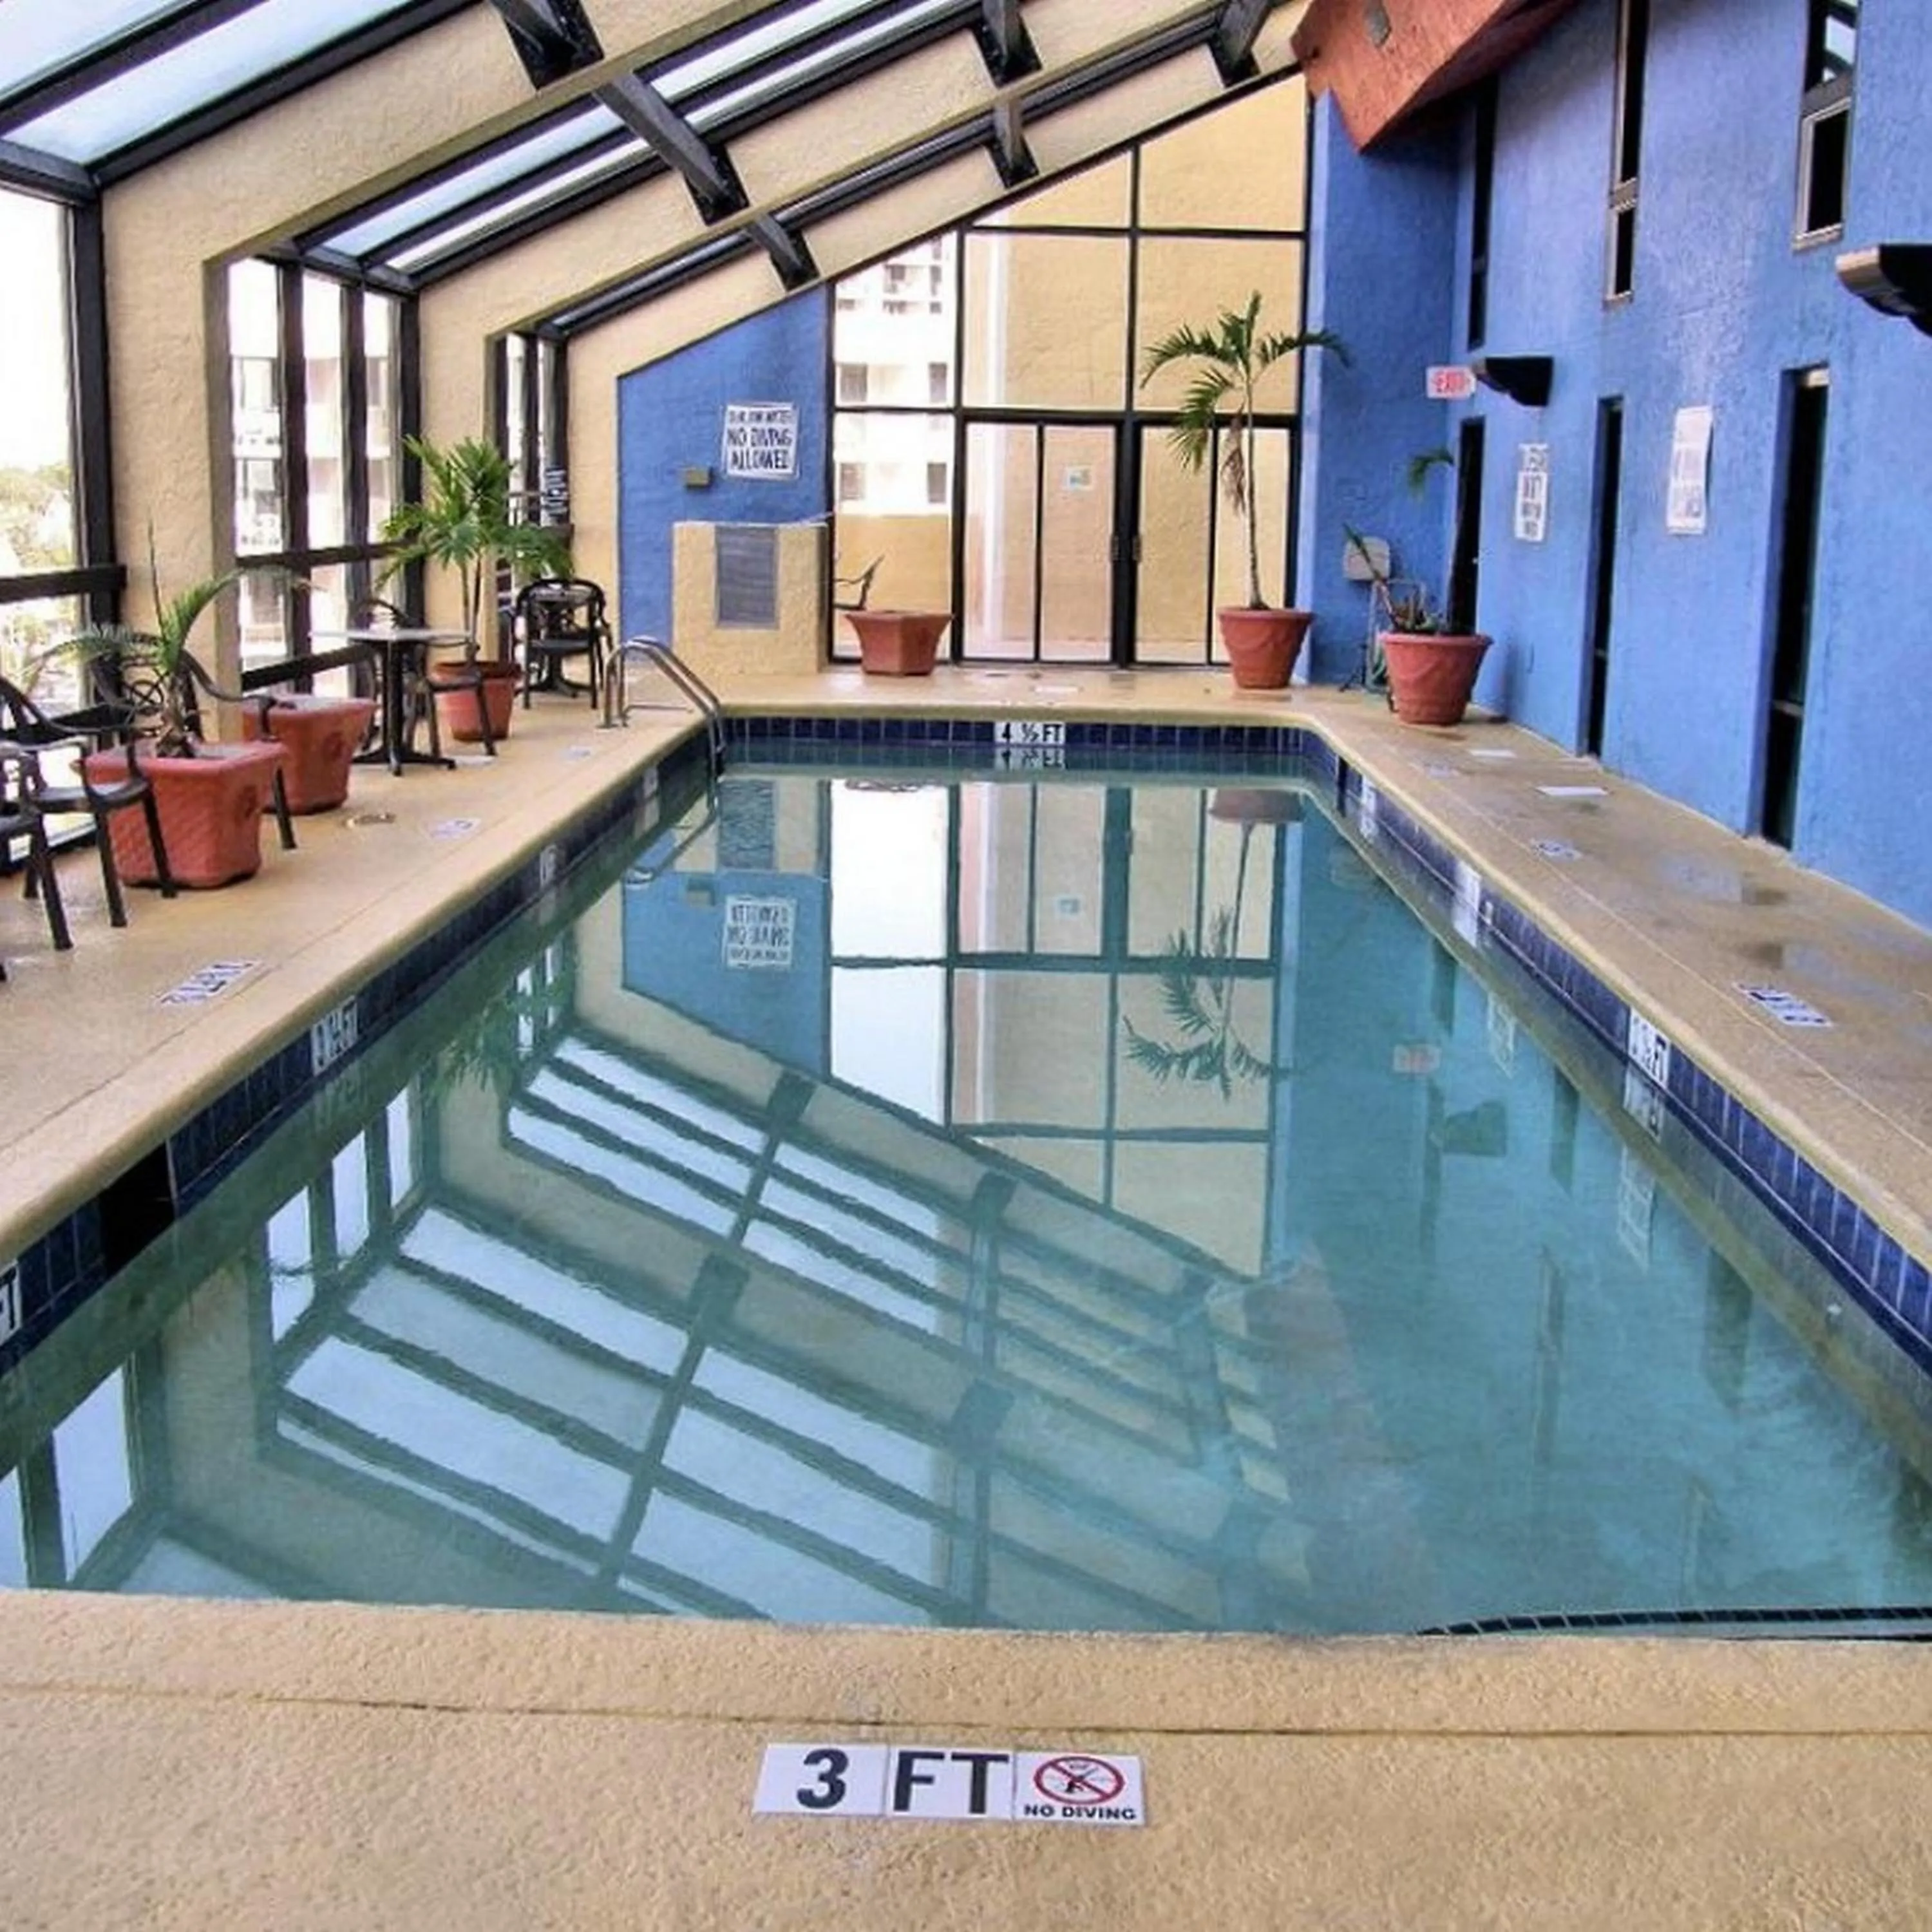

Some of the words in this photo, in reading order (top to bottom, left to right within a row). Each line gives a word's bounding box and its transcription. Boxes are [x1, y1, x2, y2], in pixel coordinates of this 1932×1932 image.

[728, 426, 747, 446] NO
[1001, 722, 1012, 743] 4
[1043, 723, 1063, 742] FT
[795, 1748, 849, 1810] 3
[892, 1750, 1010, 1815] FT
[1025, 1804, 1055, 1817] NO
[1062, 1806, 1137, 1819] DIVING
